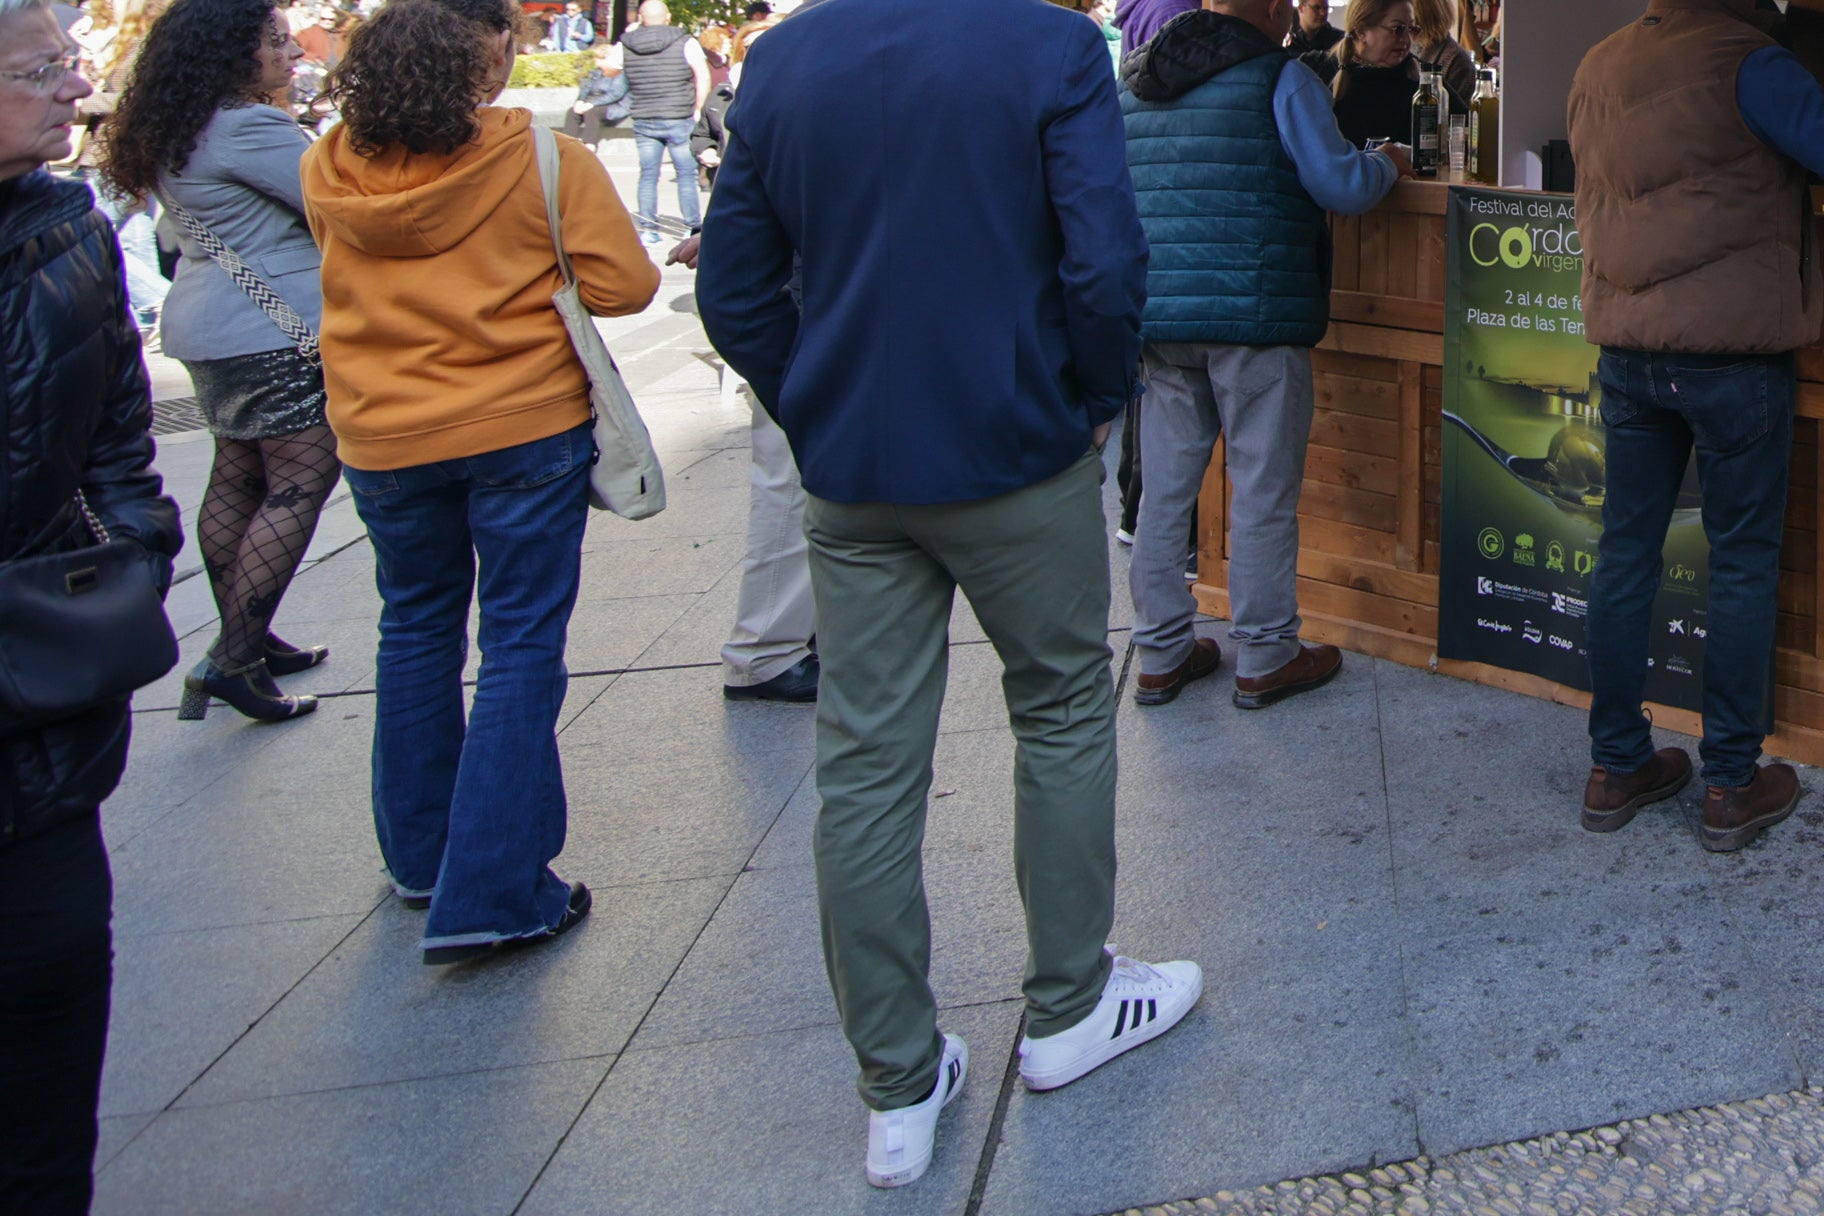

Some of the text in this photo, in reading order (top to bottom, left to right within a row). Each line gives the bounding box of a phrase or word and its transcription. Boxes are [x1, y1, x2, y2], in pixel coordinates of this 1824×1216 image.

[1470, 197, 1523, 217] Festival
[1527, 202, 1552, 218] del
[1505, 290, 1513, 305] 2
[1517, 291, 1530, 306] al
[1534, 293, 1543, 308] 4
[1547, 294, 1568, 310] de
[1467, 308, 1506, 327] Plaza
[1510, 313, 1530, 329] de
[1536, 315, 1556, 332] las
[1549, 634, 1573, 650] COVAP
